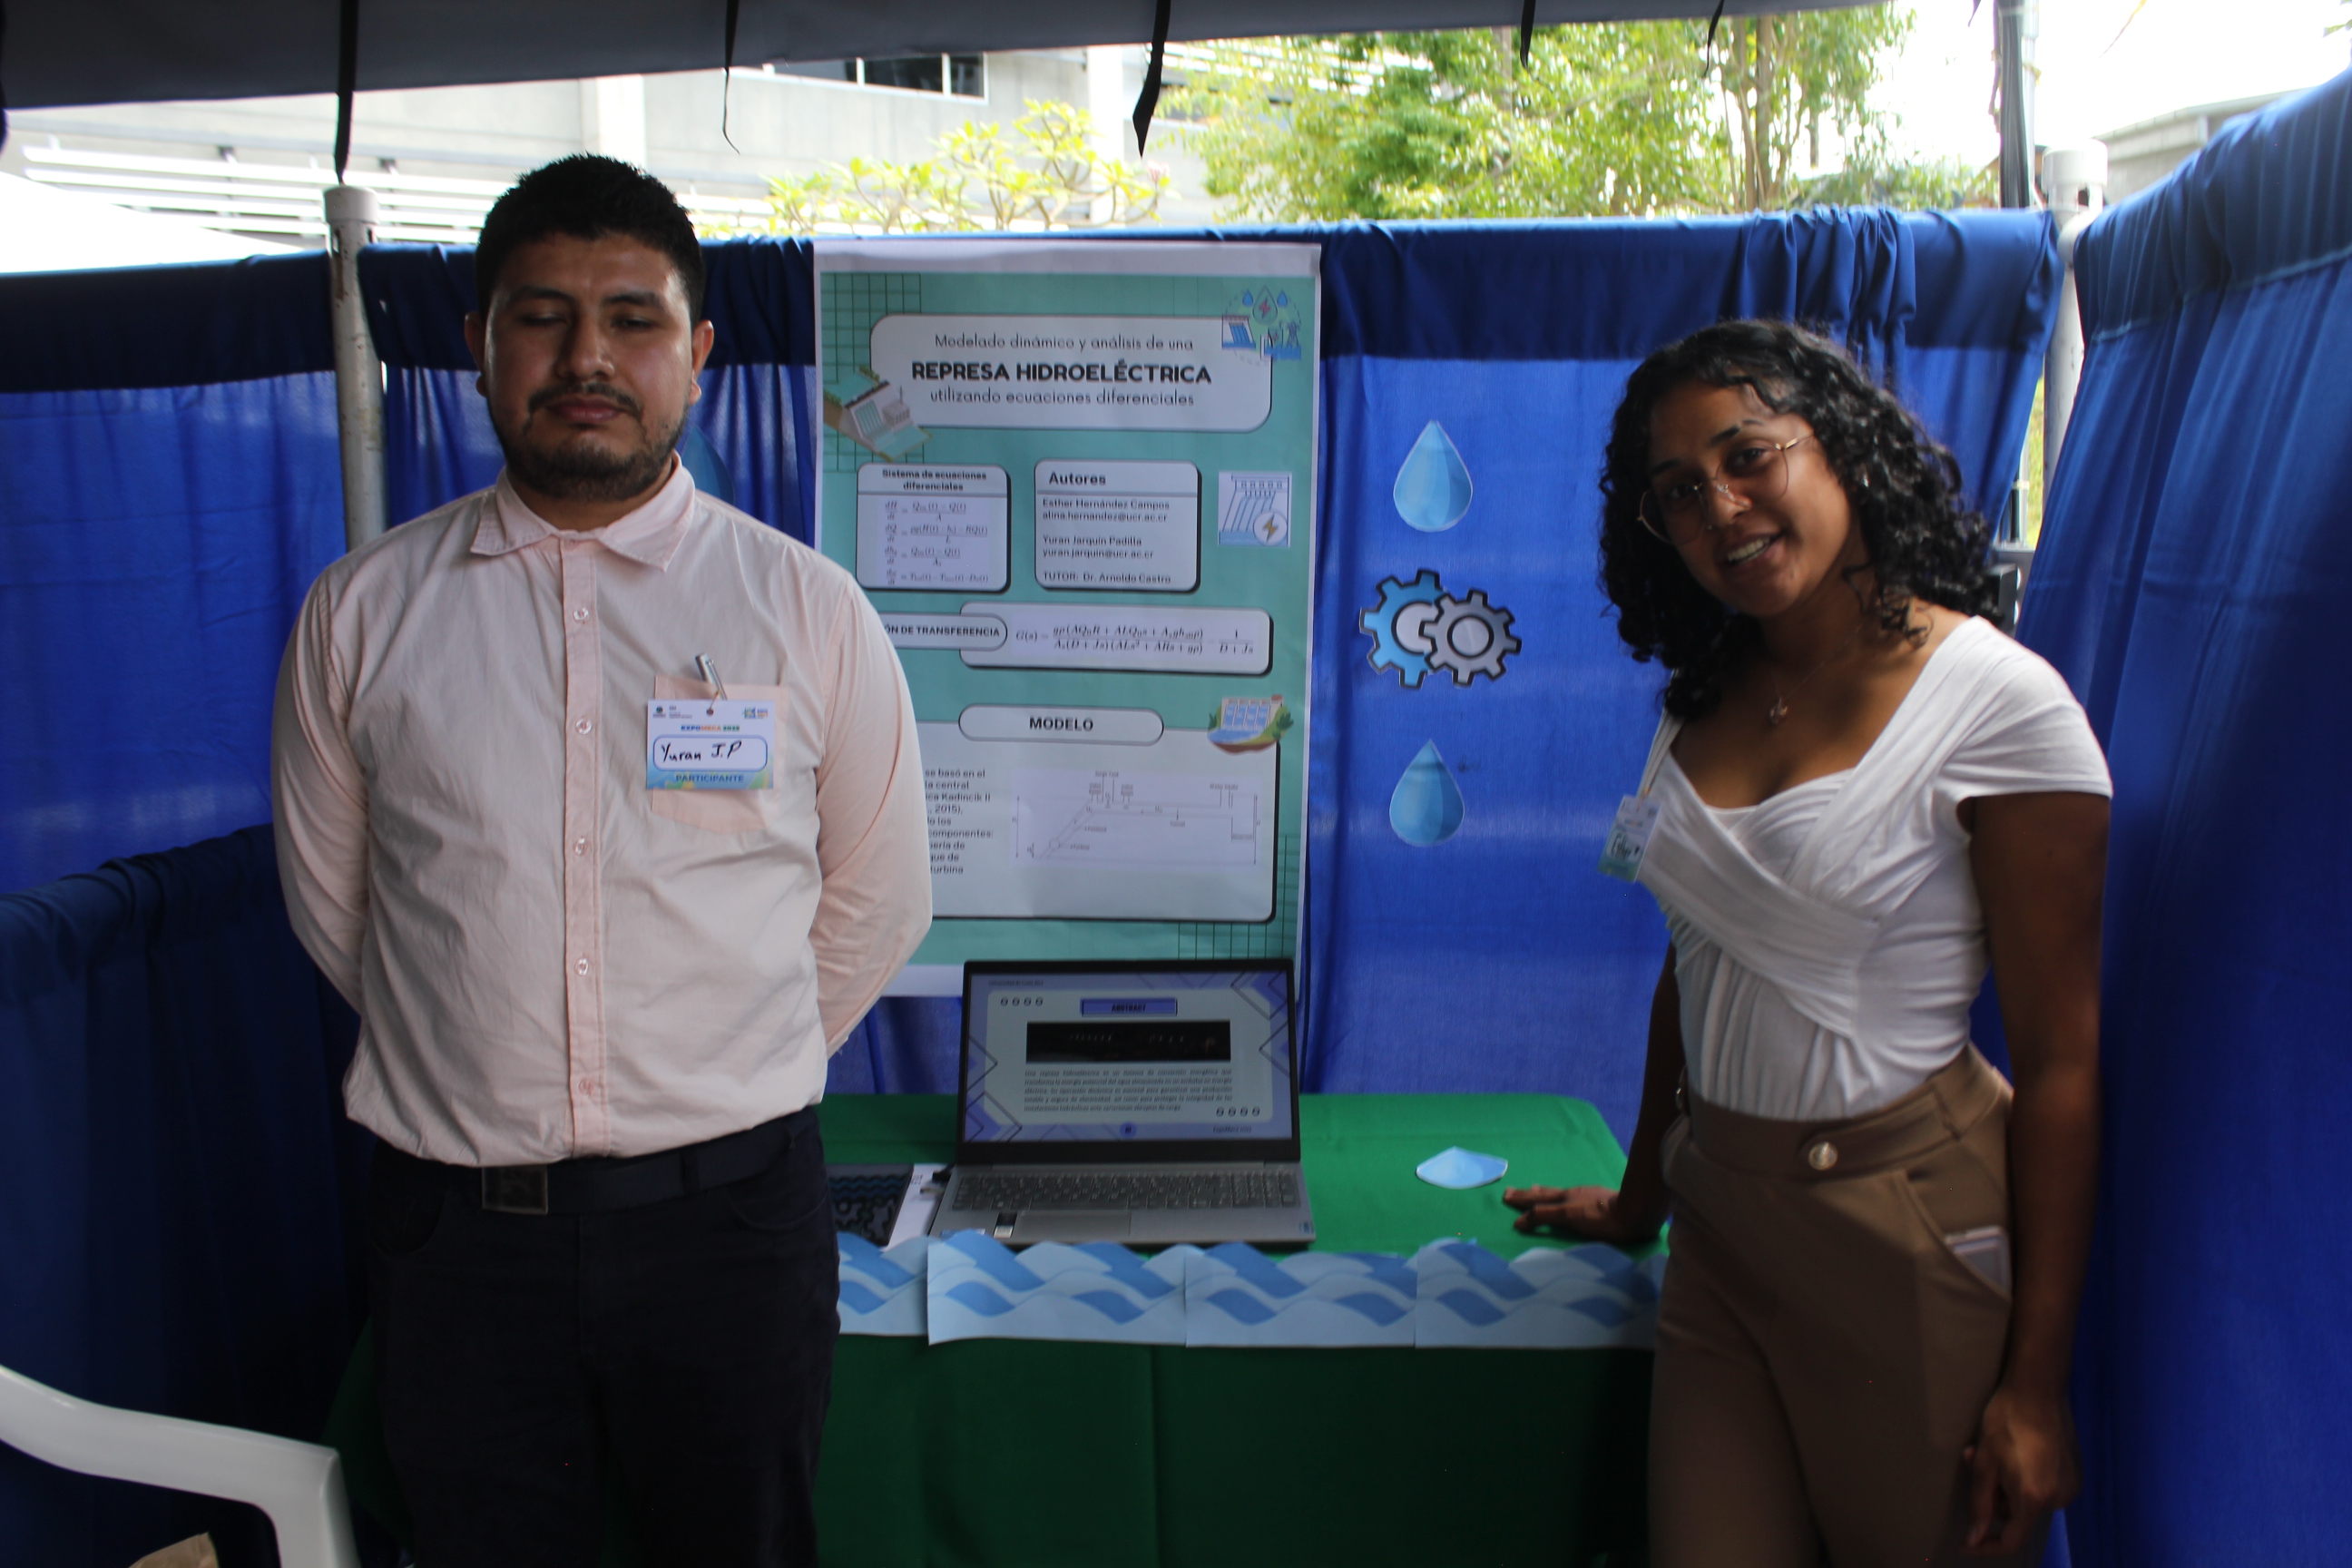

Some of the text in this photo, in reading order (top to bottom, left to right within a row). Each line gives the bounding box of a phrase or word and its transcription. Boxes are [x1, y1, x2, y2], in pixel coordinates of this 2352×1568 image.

[936, 334, 1194, 353] Modelado dinámico y análisis de una
[912, 358, 1212, 384] REPRESA HIDROELÉCTRICA
[930, 387, 1194, 407] utilizando ecuaciones diferenciales
[882, 469, 987, 480] Sistema de ecuaciones
[1049, 471, 1106, 485] Autores
[903, 481, 964, 491] diferenciales
[1043, 499, 1073, 508] Esther
[1131, 500, 1170, 511] Campos
[1043, 534, 1070, 545] Yuran
[1109, 535, 1142, 546] Padilla
[1083, 572, 1096, 583] Dr.
[1139, 573, 1171, 583] Castro
[901, 625, 914, 634] DE
[916, 625, 1000, 637] TRANSFERENCIA
[1029, 717, 1093, 731] MODELO
[661, 742, 701, 763] Yuran
[676, 774, 745, 782] PARTICIPANTE
[963, 769, 975, 778] en
[977, 768, 985, 778] el
[936, 779, 969, 789] central
[937, 816, 951, 826] los
[954, 840, 965, 850] de
[947, 851, 959, 862] de
